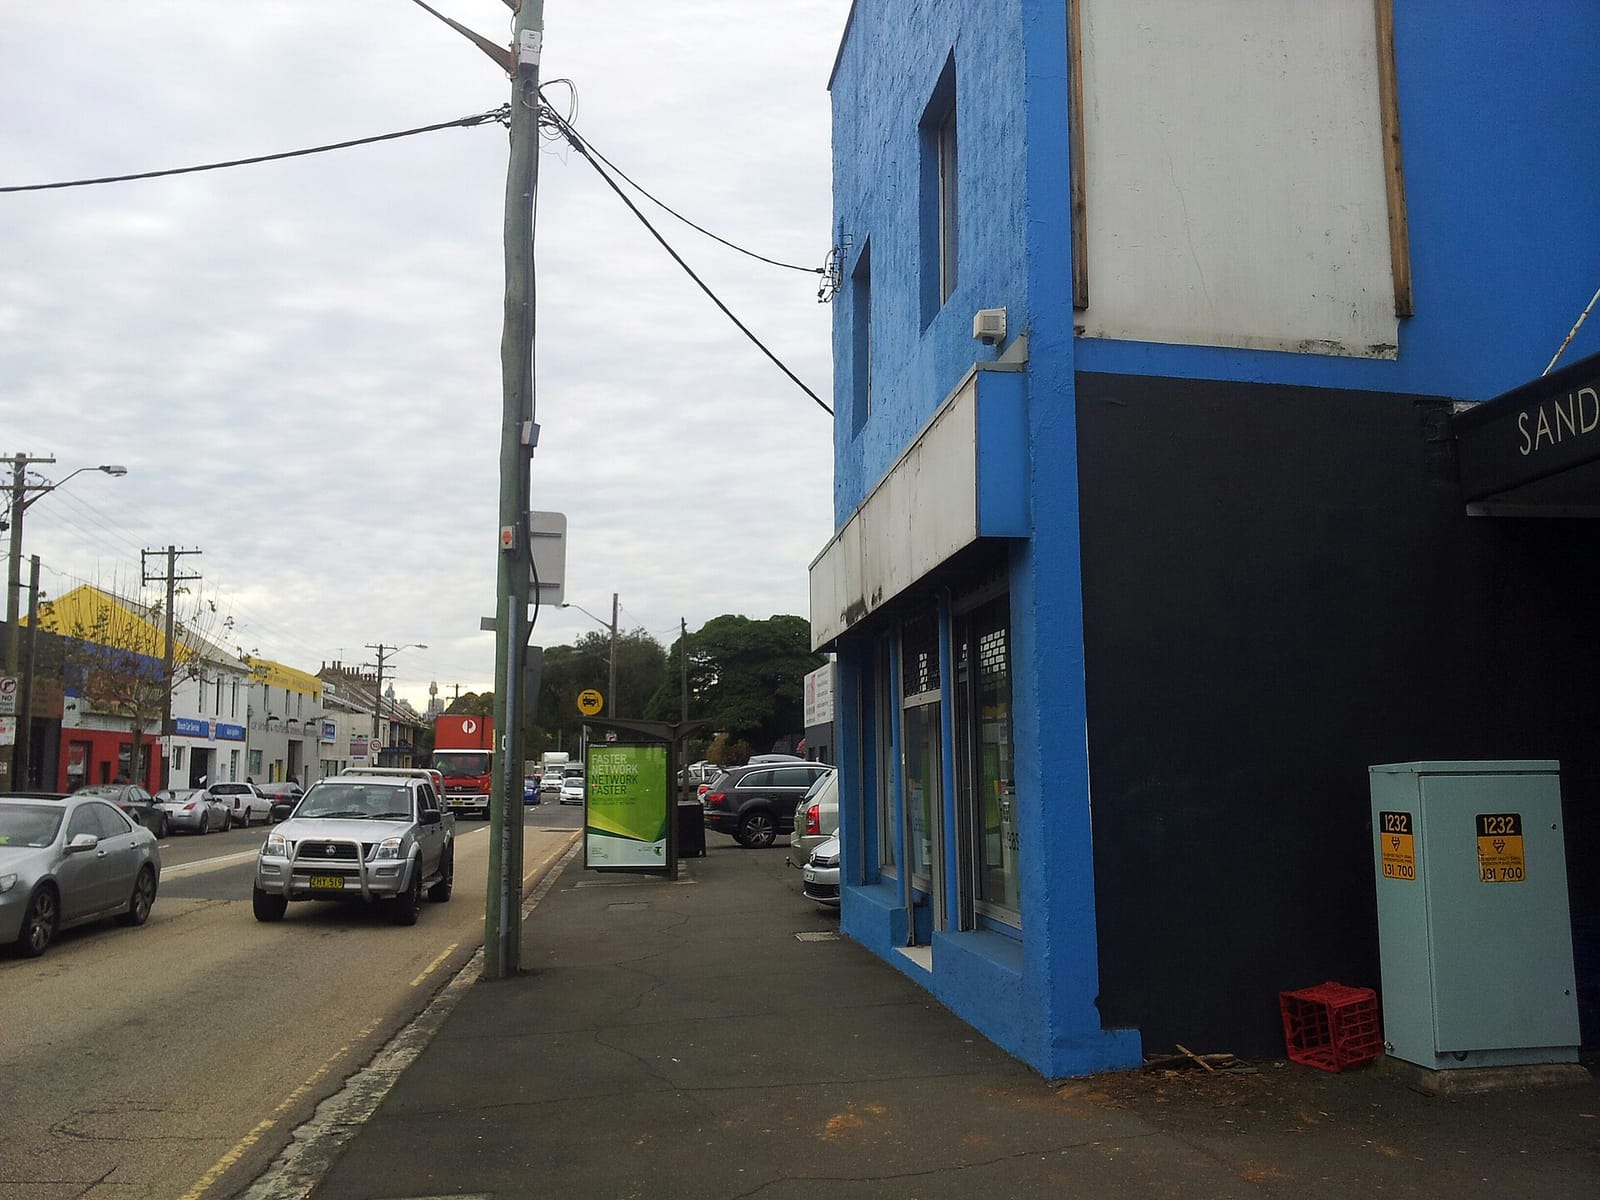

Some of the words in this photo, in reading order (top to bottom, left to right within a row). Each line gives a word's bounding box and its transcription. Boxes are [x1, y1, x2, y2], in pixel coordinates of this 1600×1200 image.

[1518, 387, 1600, 456] SAND
[591, 754, 628, 764] FASTER
[591, 764, 639, 775] NETWORK
[591, 775, 639, 785] NETWORK
[591, 785, 628, 795] FASTER
[1384, 814, 1408, 832] 1232
[1483, 816, 1516, 835] 1232
[1384, 863, 1395, 876] 131
[1397, 864, 1414, 878] 700
[1482, 868, 1497, 880] 131
[1500, 867, 1523, 880] 700
